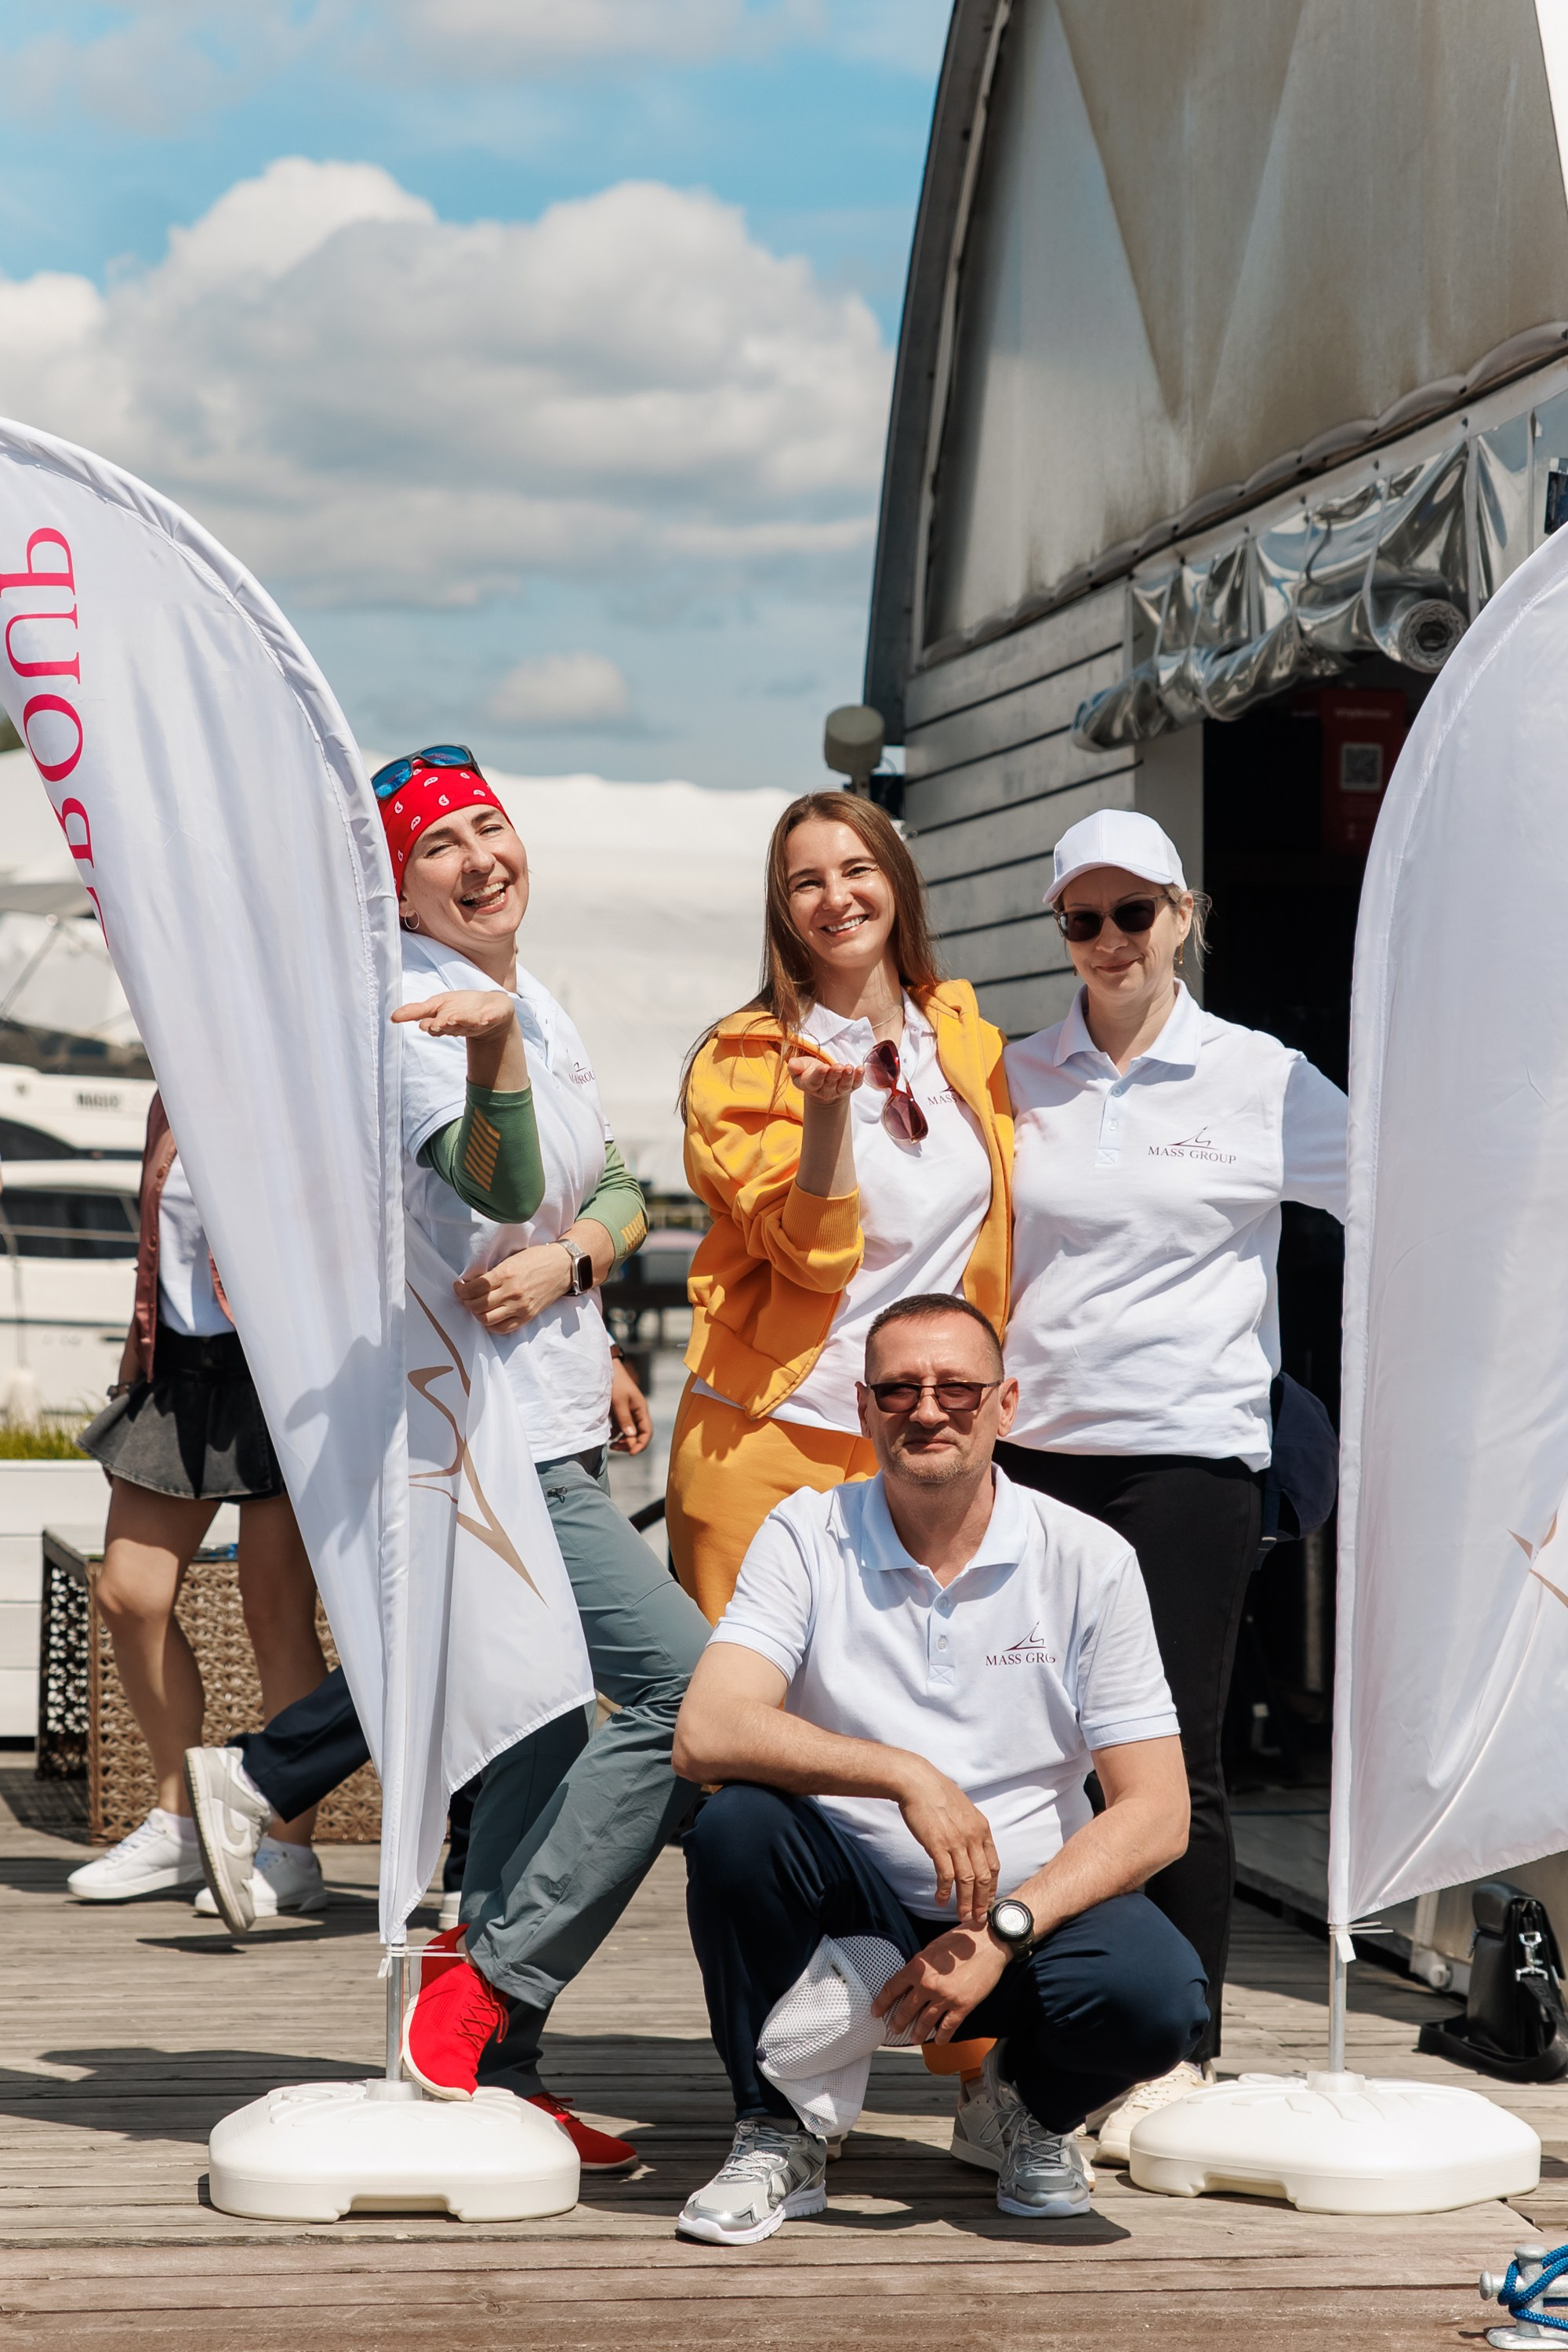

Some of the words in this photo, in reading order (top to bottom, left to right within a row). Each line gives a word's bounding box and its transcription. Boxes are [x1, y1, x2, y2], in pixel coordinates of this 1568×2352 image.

[927, 1094, 957, 1105] MASS
[1148, 1146, 1185, 1158] MASS
[1189, 1149, 1236, 1164] GROUP
[985, 1653, 1022, 1666] MASS
